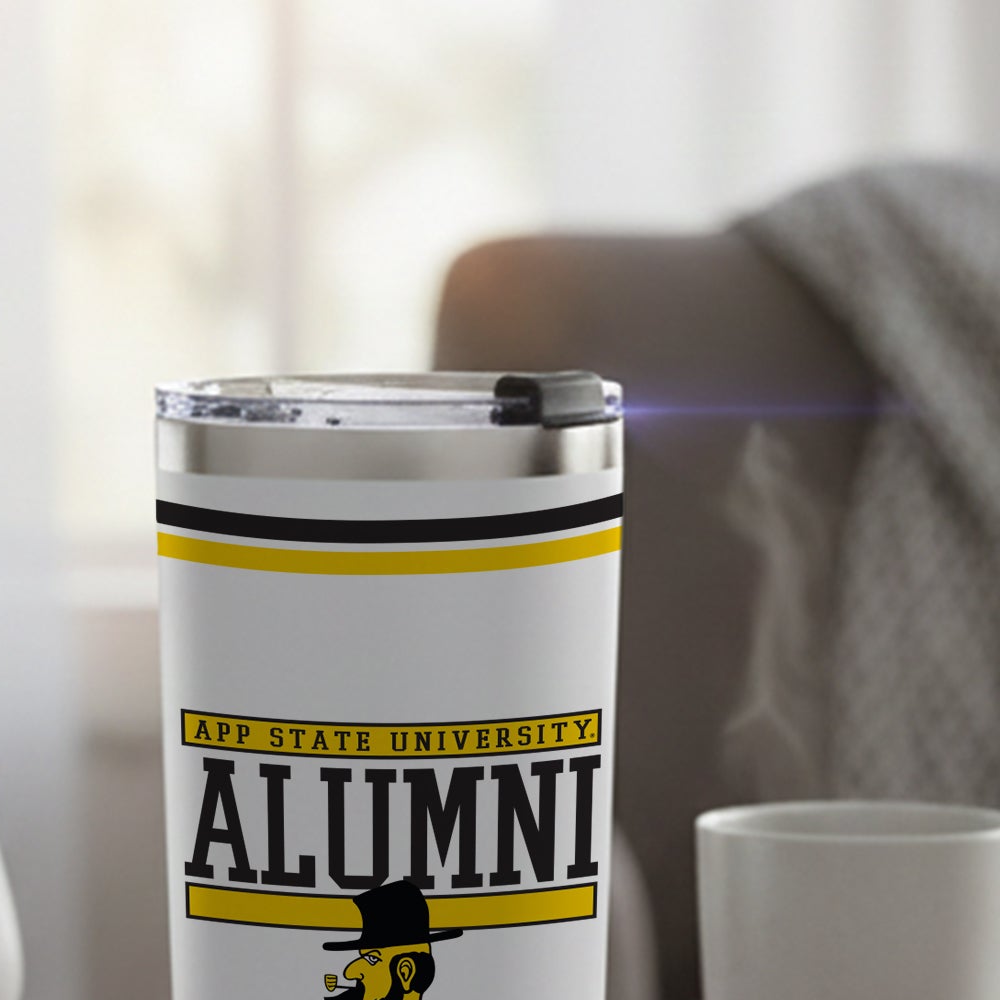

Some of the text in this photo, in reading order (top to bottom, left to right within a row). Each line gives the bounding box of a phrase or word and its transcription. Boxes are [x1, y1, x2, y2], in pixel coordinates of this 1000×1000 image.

[194, 719, 593, 752] APP STATE UNIVERSITY
[184, 754, 601, 890] ALUMNI
